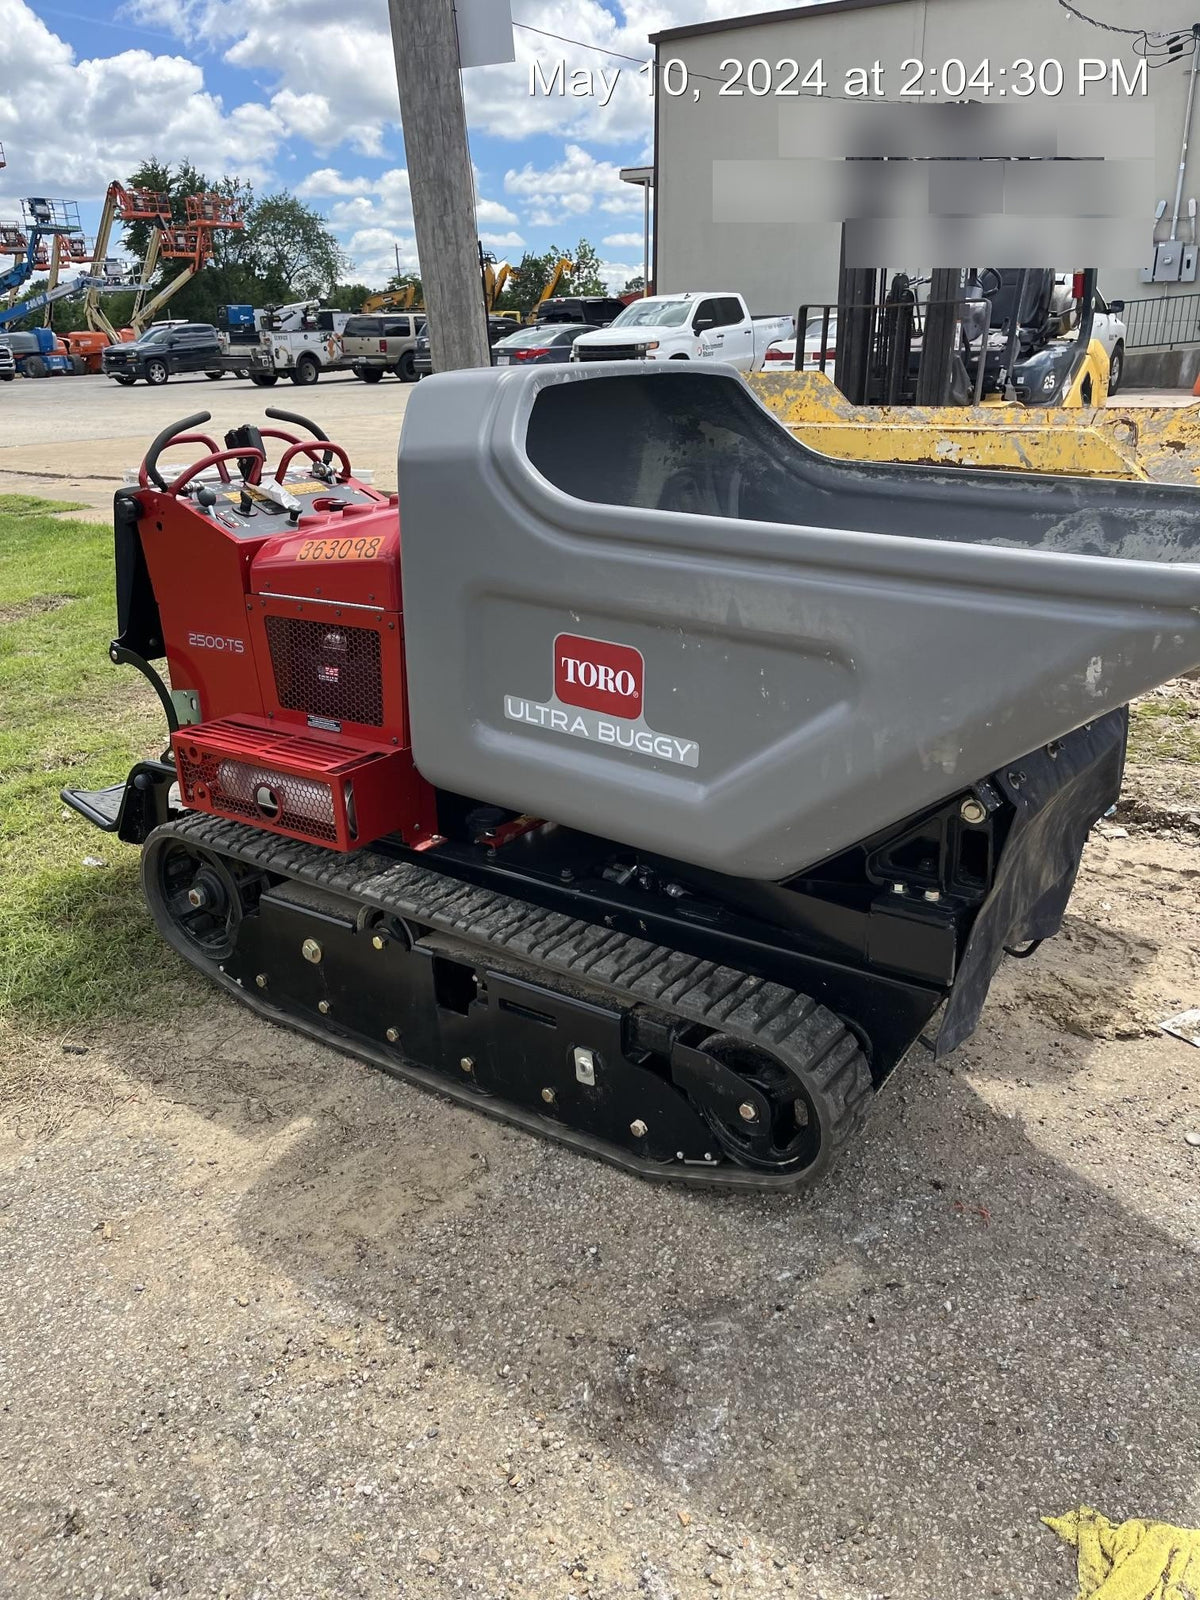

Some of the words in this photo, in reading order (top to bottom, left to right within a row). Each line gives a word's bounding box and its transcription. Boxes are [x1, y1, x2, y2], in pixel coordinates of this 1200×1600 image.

[1043, 375, 1056, 390] 25
[299, 537, 381, 561] 363098
[561, 656, 636, 697] TORO
[507, 698, 589, 737] ULTRA
[598, 721, 692, 762] BUGGY
